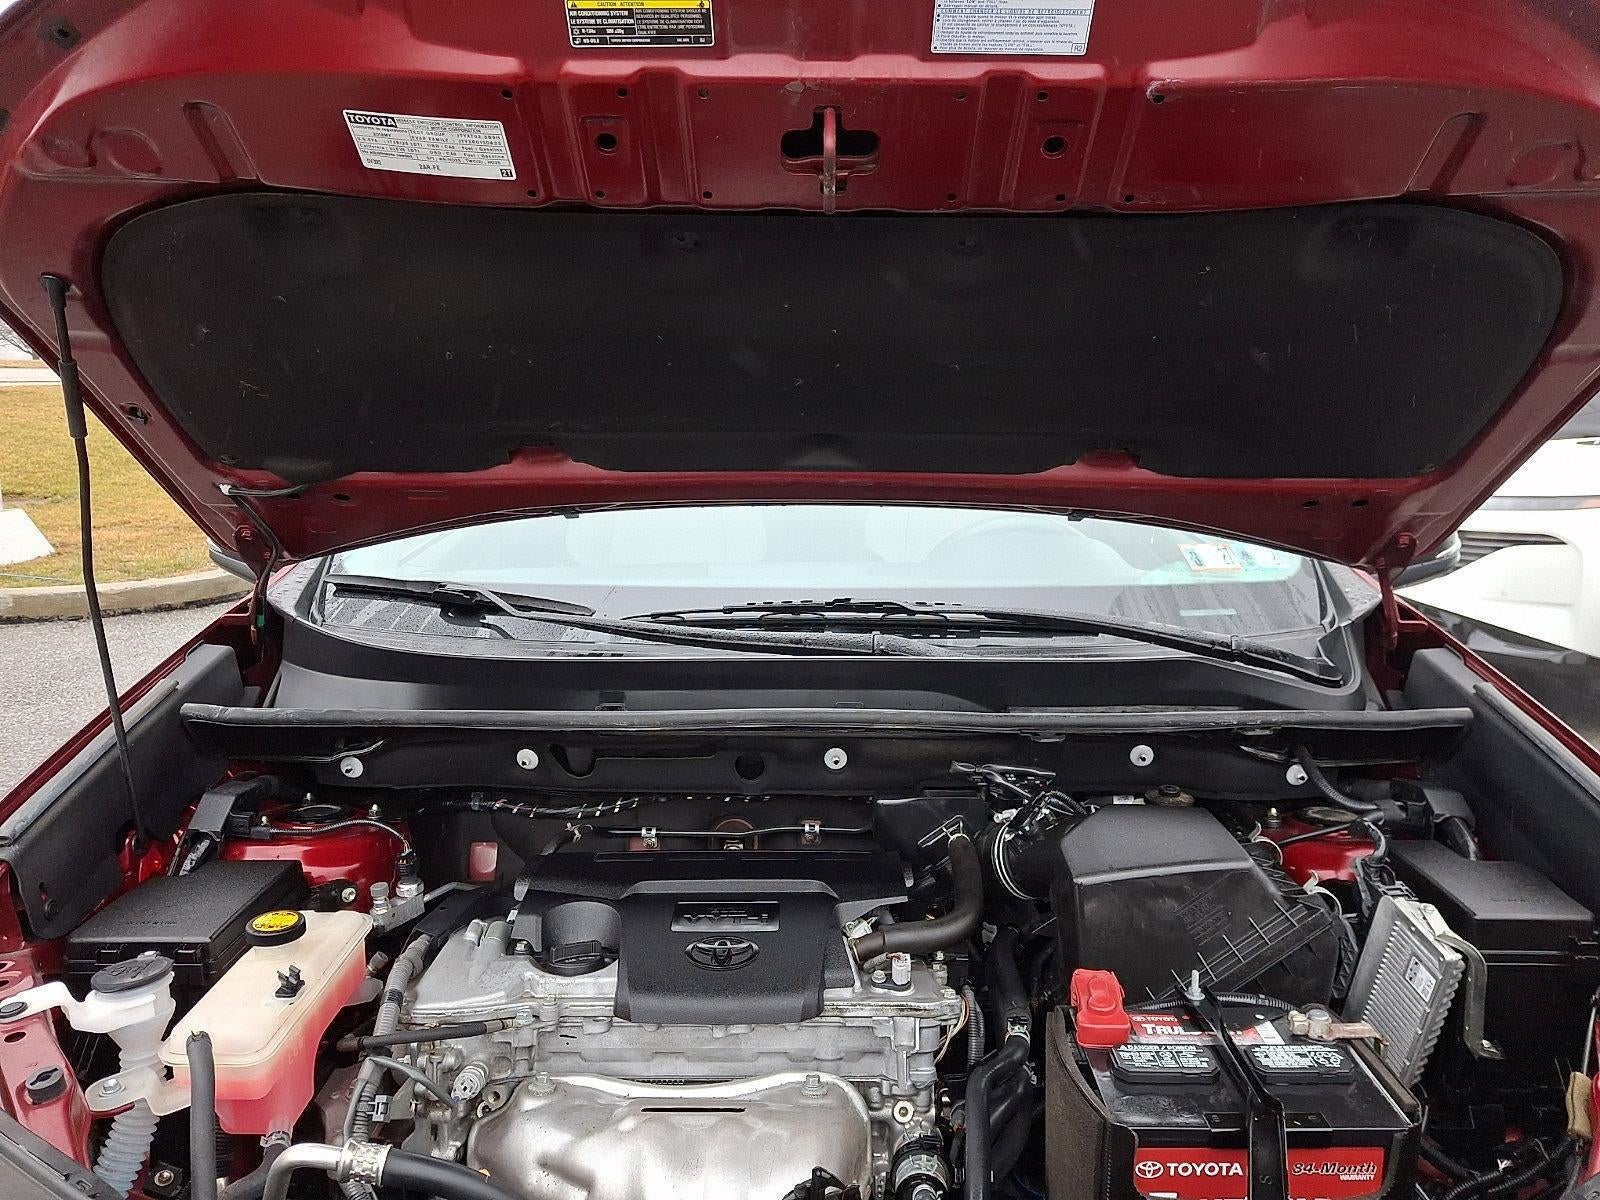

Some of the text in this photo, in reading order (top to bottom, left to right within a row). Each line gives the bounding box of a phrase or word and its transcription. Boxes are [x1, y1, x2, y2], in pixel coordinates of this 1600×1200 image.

[347, 114, 396, 126] TOYOTA
[419, 163, 441, 171] 2AR-FE
[1166, 1162, 1243, 1177] TOYOTA
[1292, 1162, 1377, 1175] 84-Month
